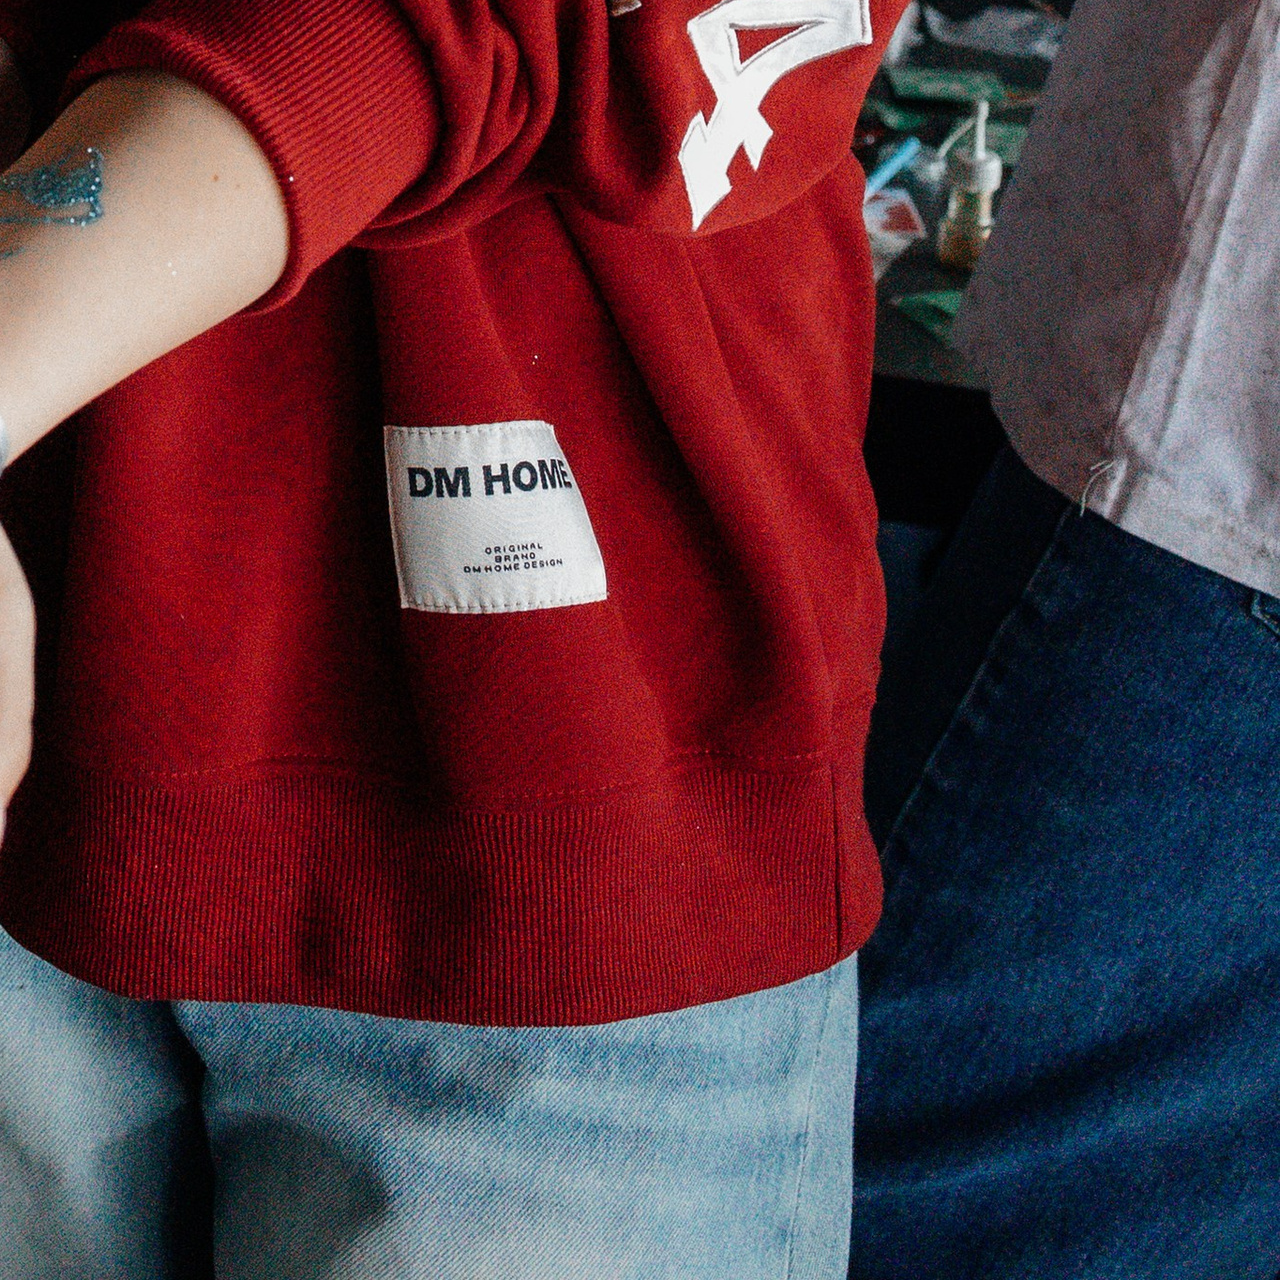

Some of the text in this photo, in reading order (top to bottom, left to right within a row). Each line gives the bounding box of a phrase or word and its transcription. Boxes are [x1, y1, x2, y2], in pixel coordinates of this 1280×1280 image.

[407, 458, 573, 498] DM HOME
[484, 542, 544, 555] ORIGINAL
[494, 551, 536, 564] BRAND
[463, 558, 563, 574] DM HOME DESIGN
